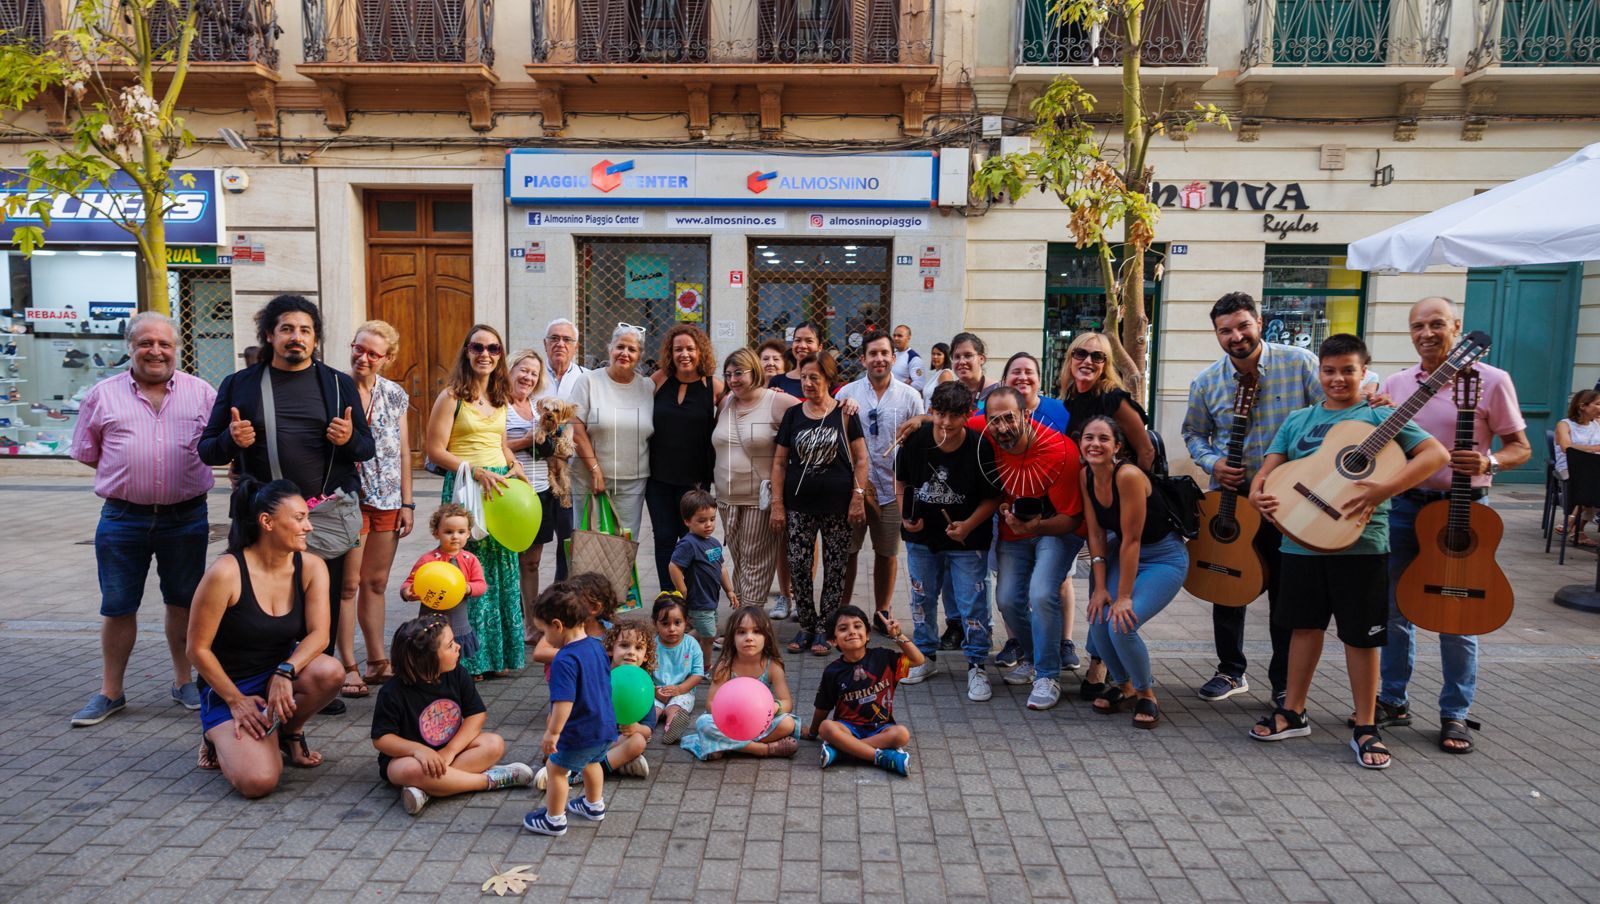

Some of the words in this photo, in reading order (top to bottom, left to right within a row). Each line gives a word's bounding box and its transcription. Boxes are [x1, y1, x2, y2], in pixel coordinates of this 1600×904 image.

[524, 175, 588, 188] PIAGGIO
[623, 175, 688, 188] CENTER
[779, 176, 879, 190] ALMOSNINO
[544, 214, 583, 224] Almosnino
[585, 214, 613, 226] Piaggio
[615, 214, 639, 224] Center
[676, 215, 776, 225] www.almosnino.es
[829, 216, 922, 228] almosninopiaggio
[1263, 213, 1319, 240] Regalos
[27, 310, 78, 320] REBAJAS
